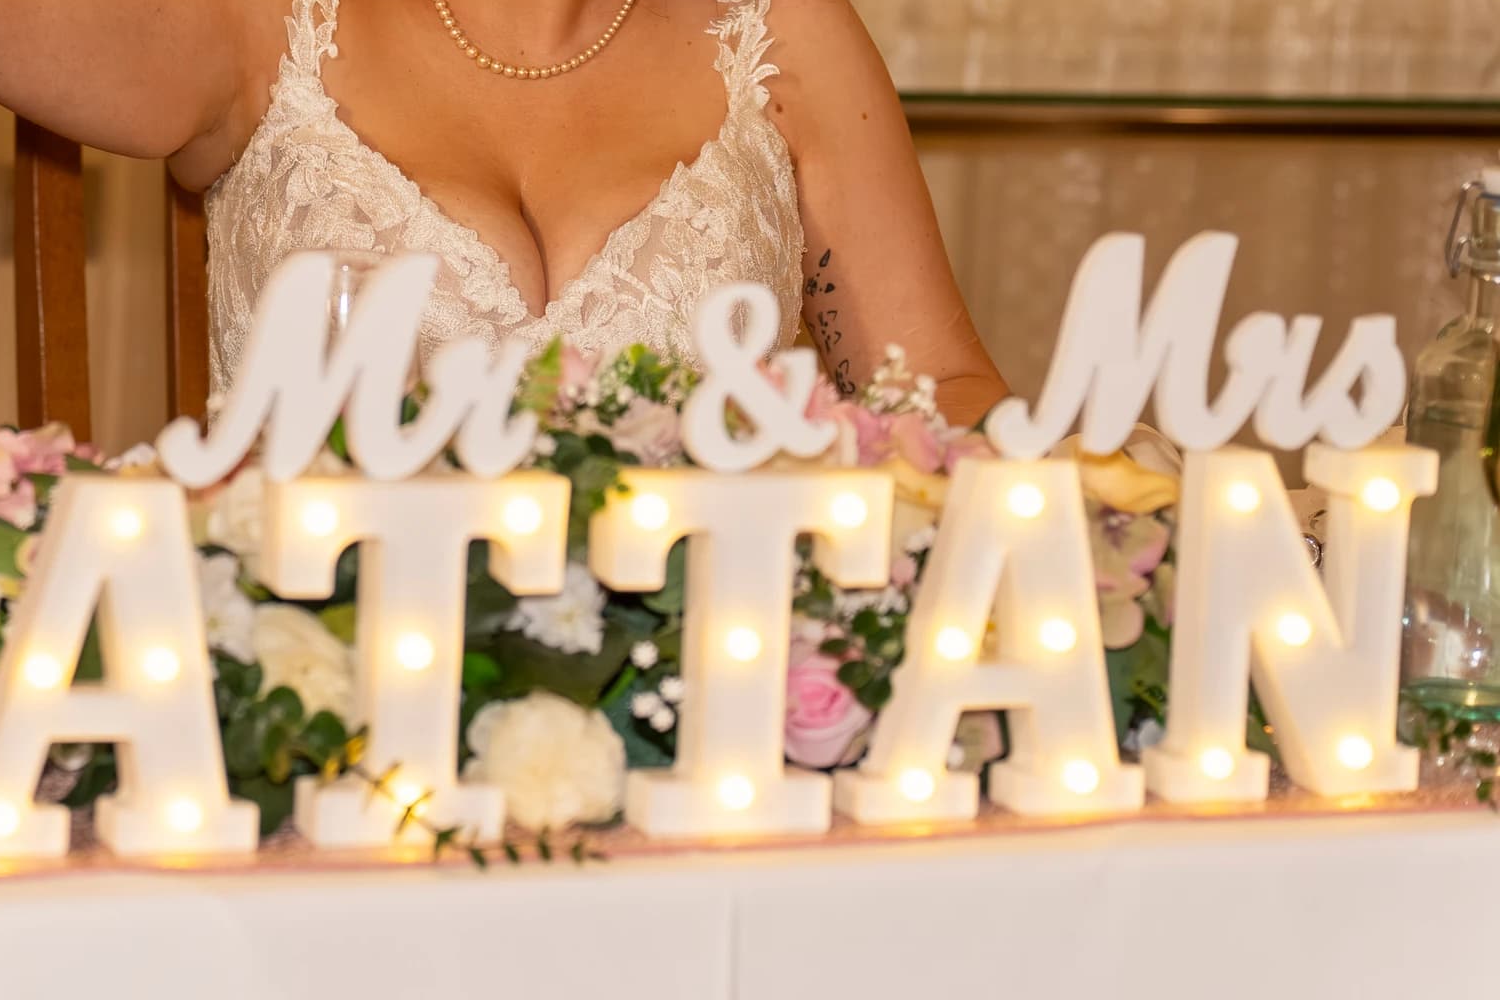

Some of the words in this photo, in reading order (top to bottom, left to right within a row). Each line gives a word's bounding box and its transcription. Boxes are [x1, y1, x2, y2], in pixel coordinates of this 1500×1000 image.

[158, 251, 536, 484] Mr
[681, 282, 840, 473] &
[984, 231, 1406, 460] Mrs
